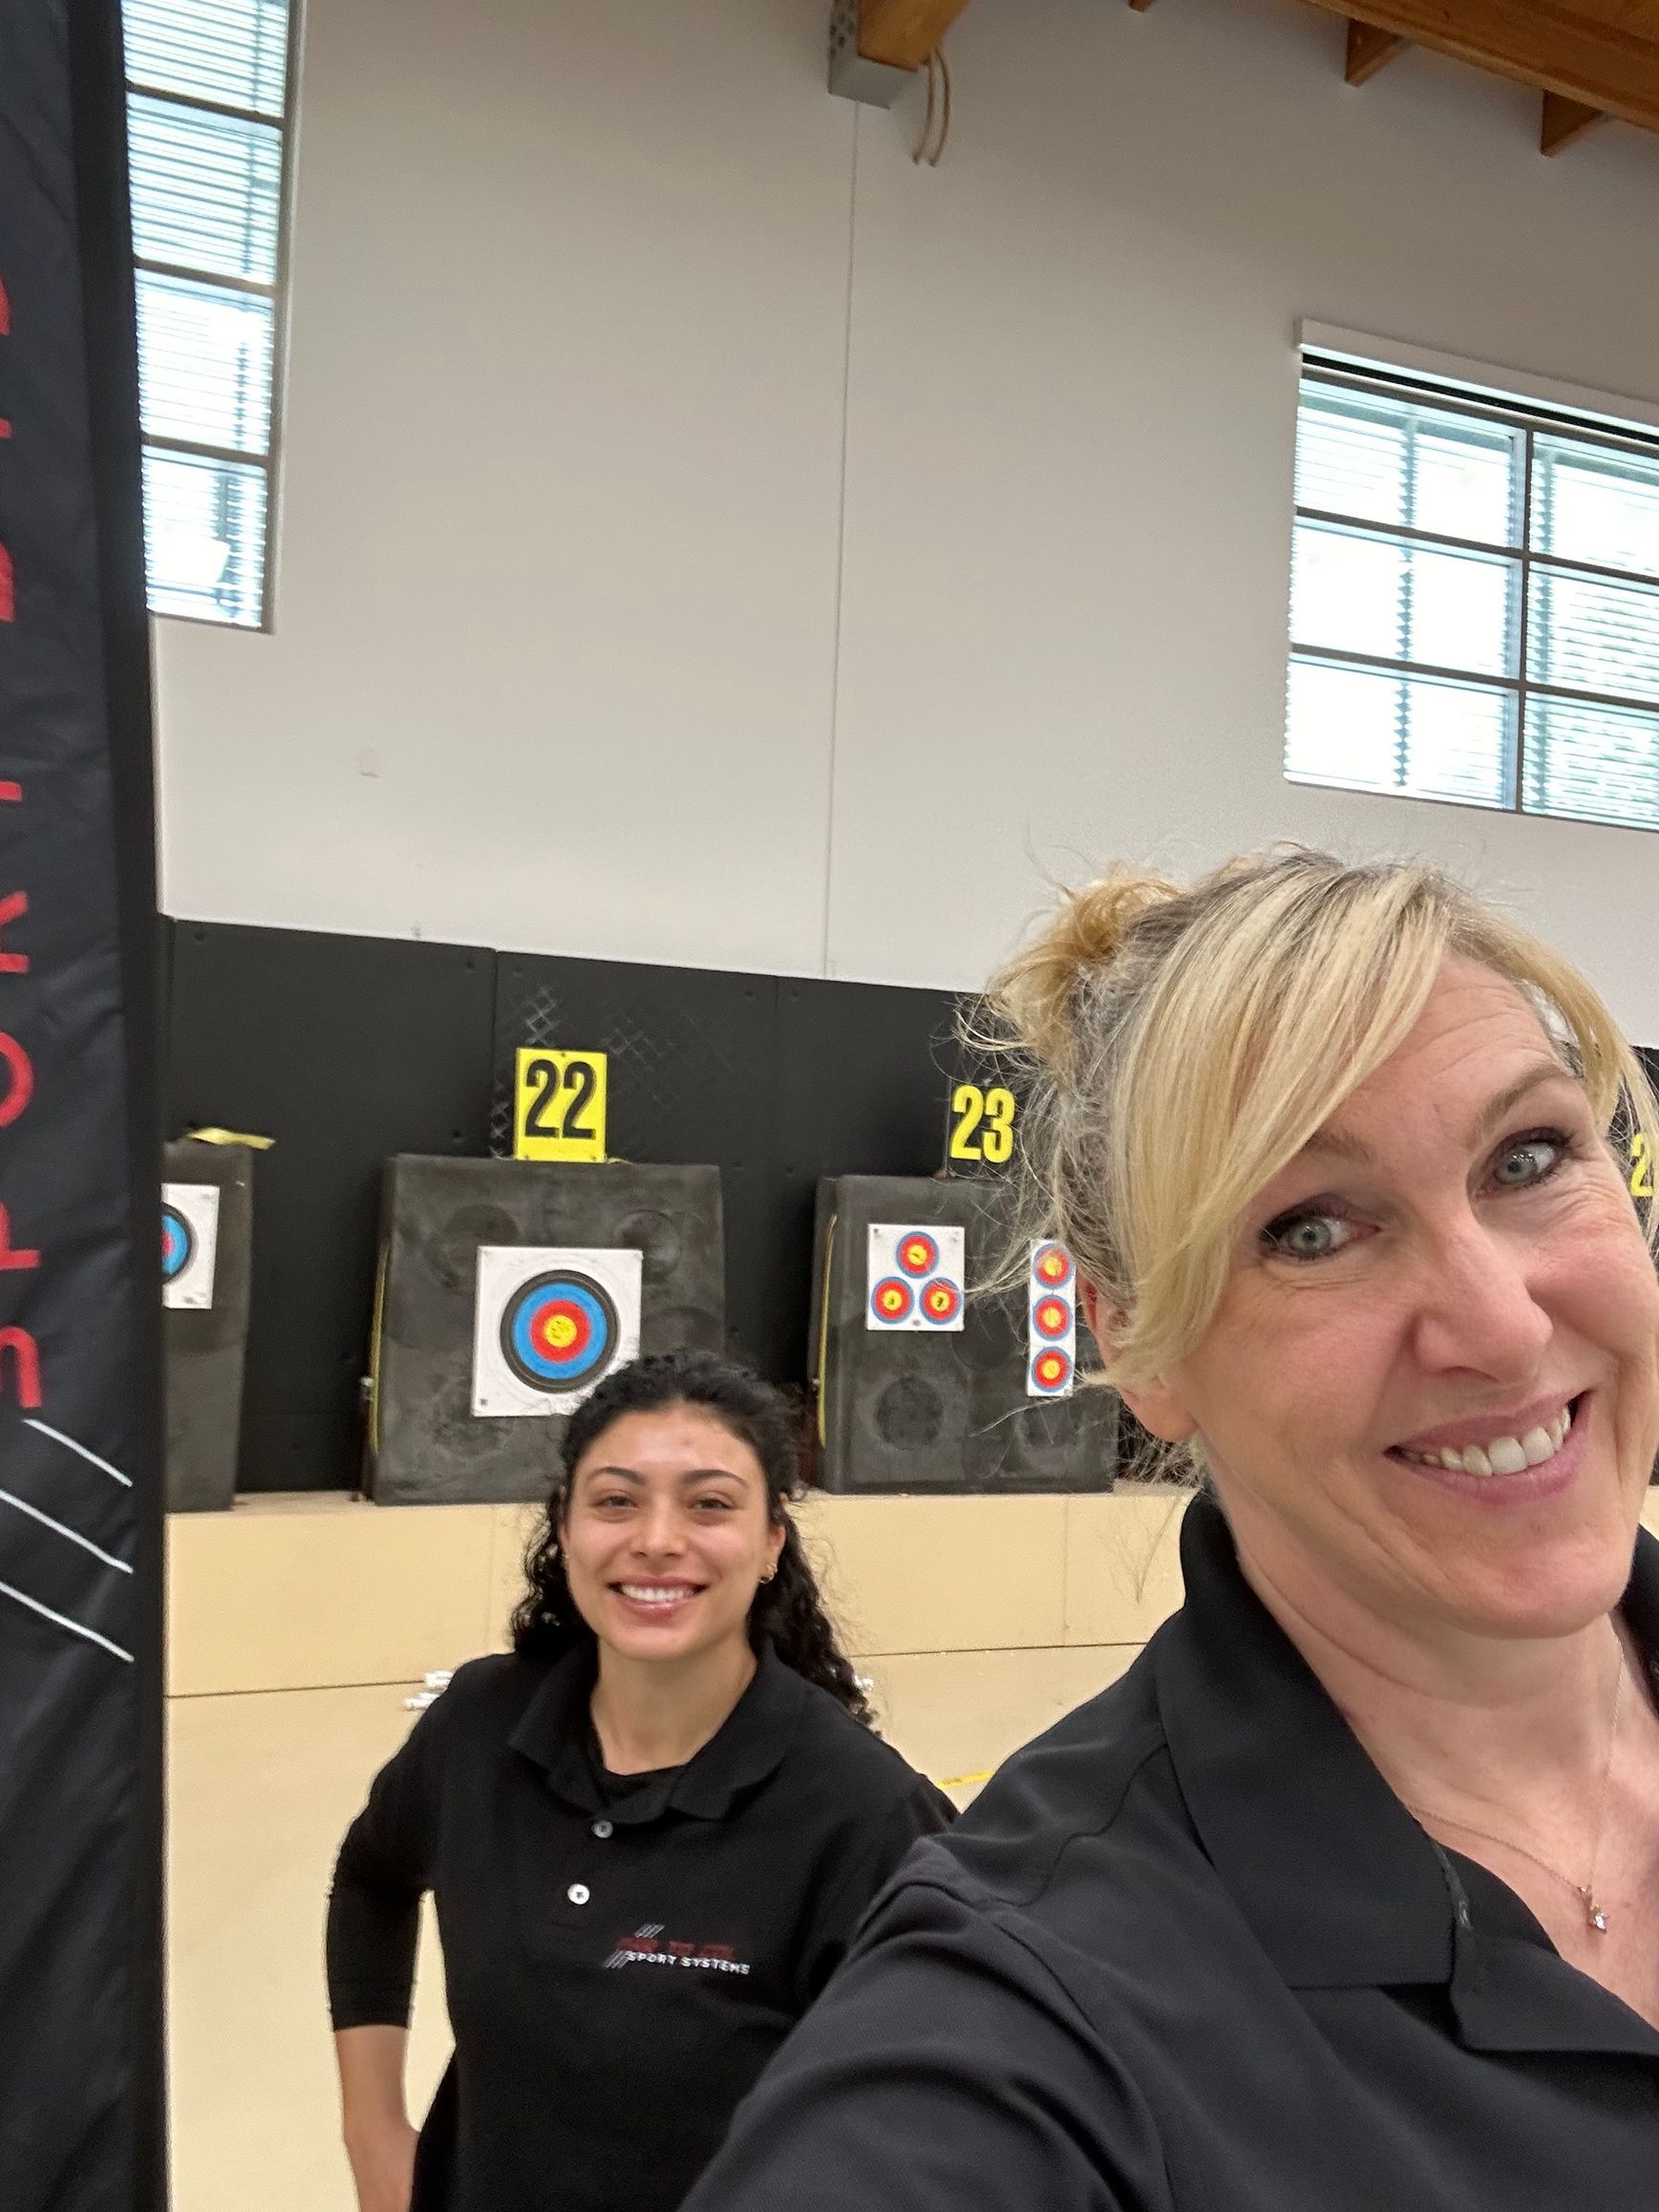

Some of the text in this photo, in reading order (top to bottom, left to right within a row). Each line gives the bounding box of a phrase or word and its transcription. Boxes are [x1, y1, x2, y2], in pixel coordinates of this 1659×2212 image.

[525, 1059, 598, 1140] 22
[950, 1084, 1015, 1163] 23
[626, 1950, 751, 1976] SPORT SYSTEMS
